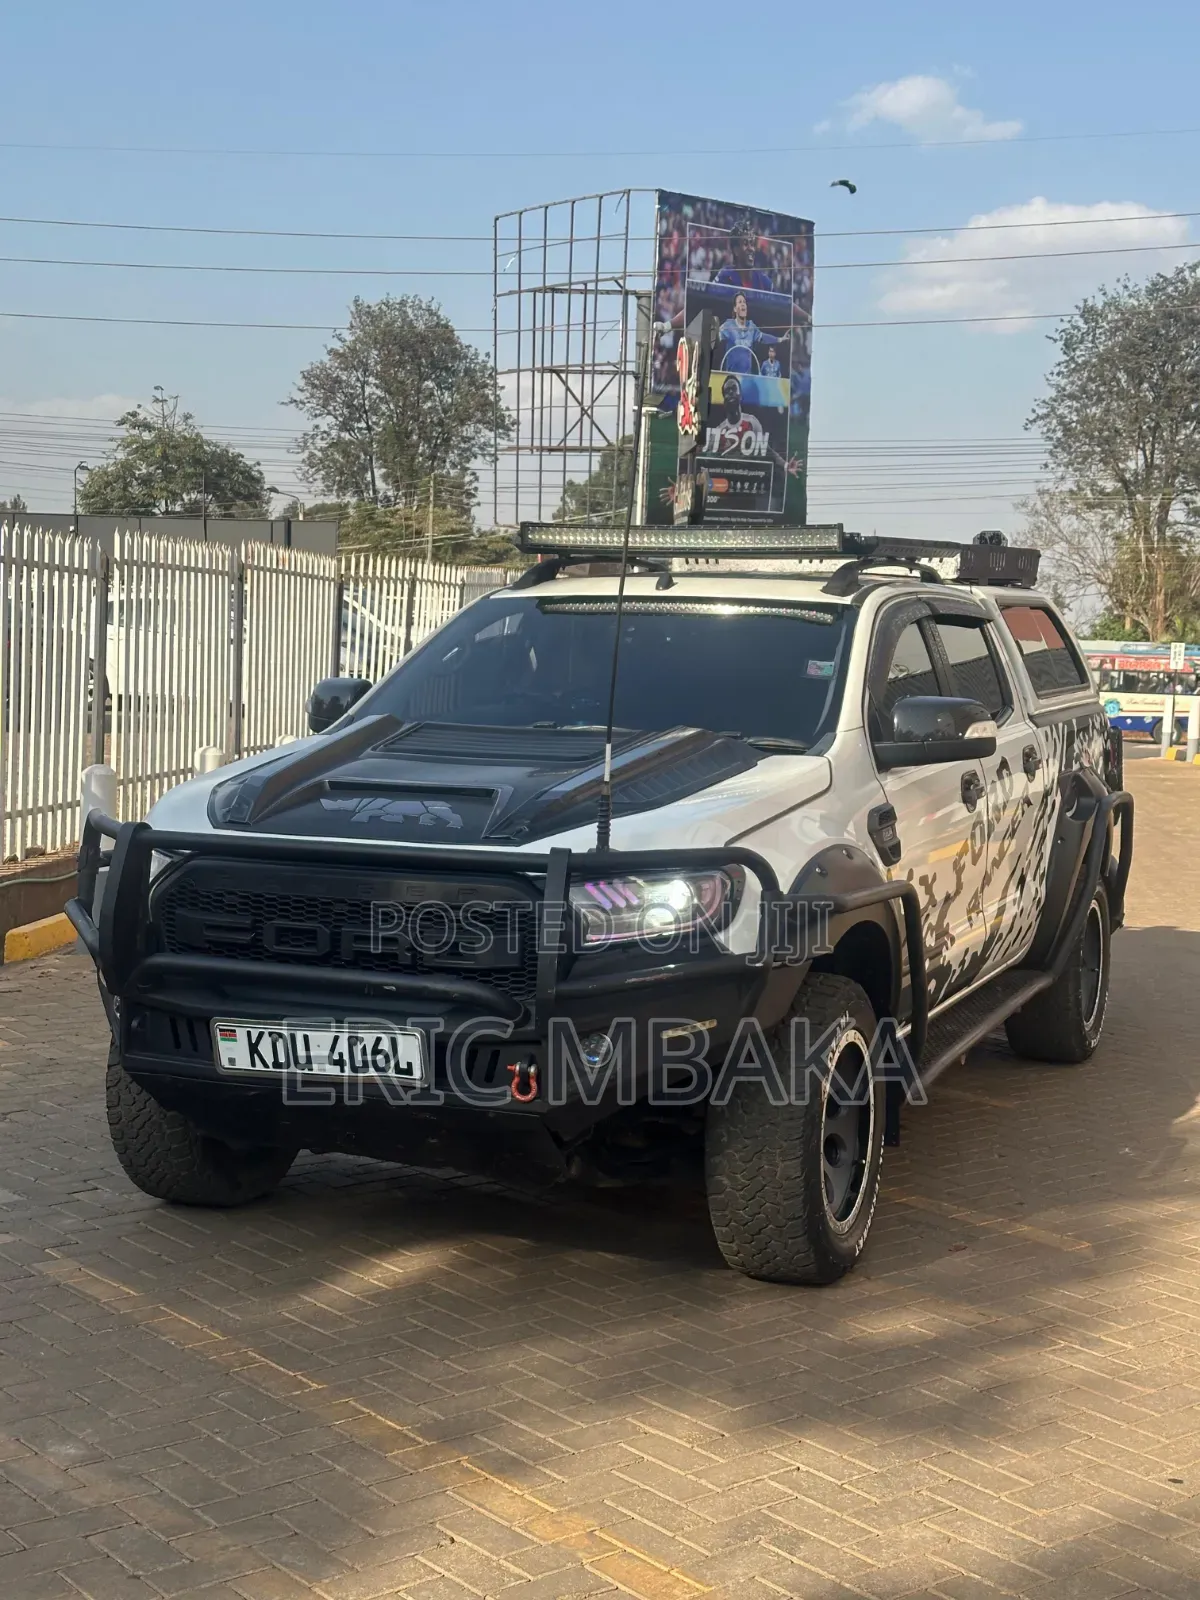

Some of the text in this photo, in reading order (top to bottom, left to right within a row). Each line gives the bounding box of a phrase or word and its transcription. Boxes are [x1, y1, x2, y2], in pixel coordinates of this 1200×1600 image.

[741, 430, 770, 456] ON
[175, 910, 524, 967] FORD
[246, 1029, 414, 1077] KDU 406L
